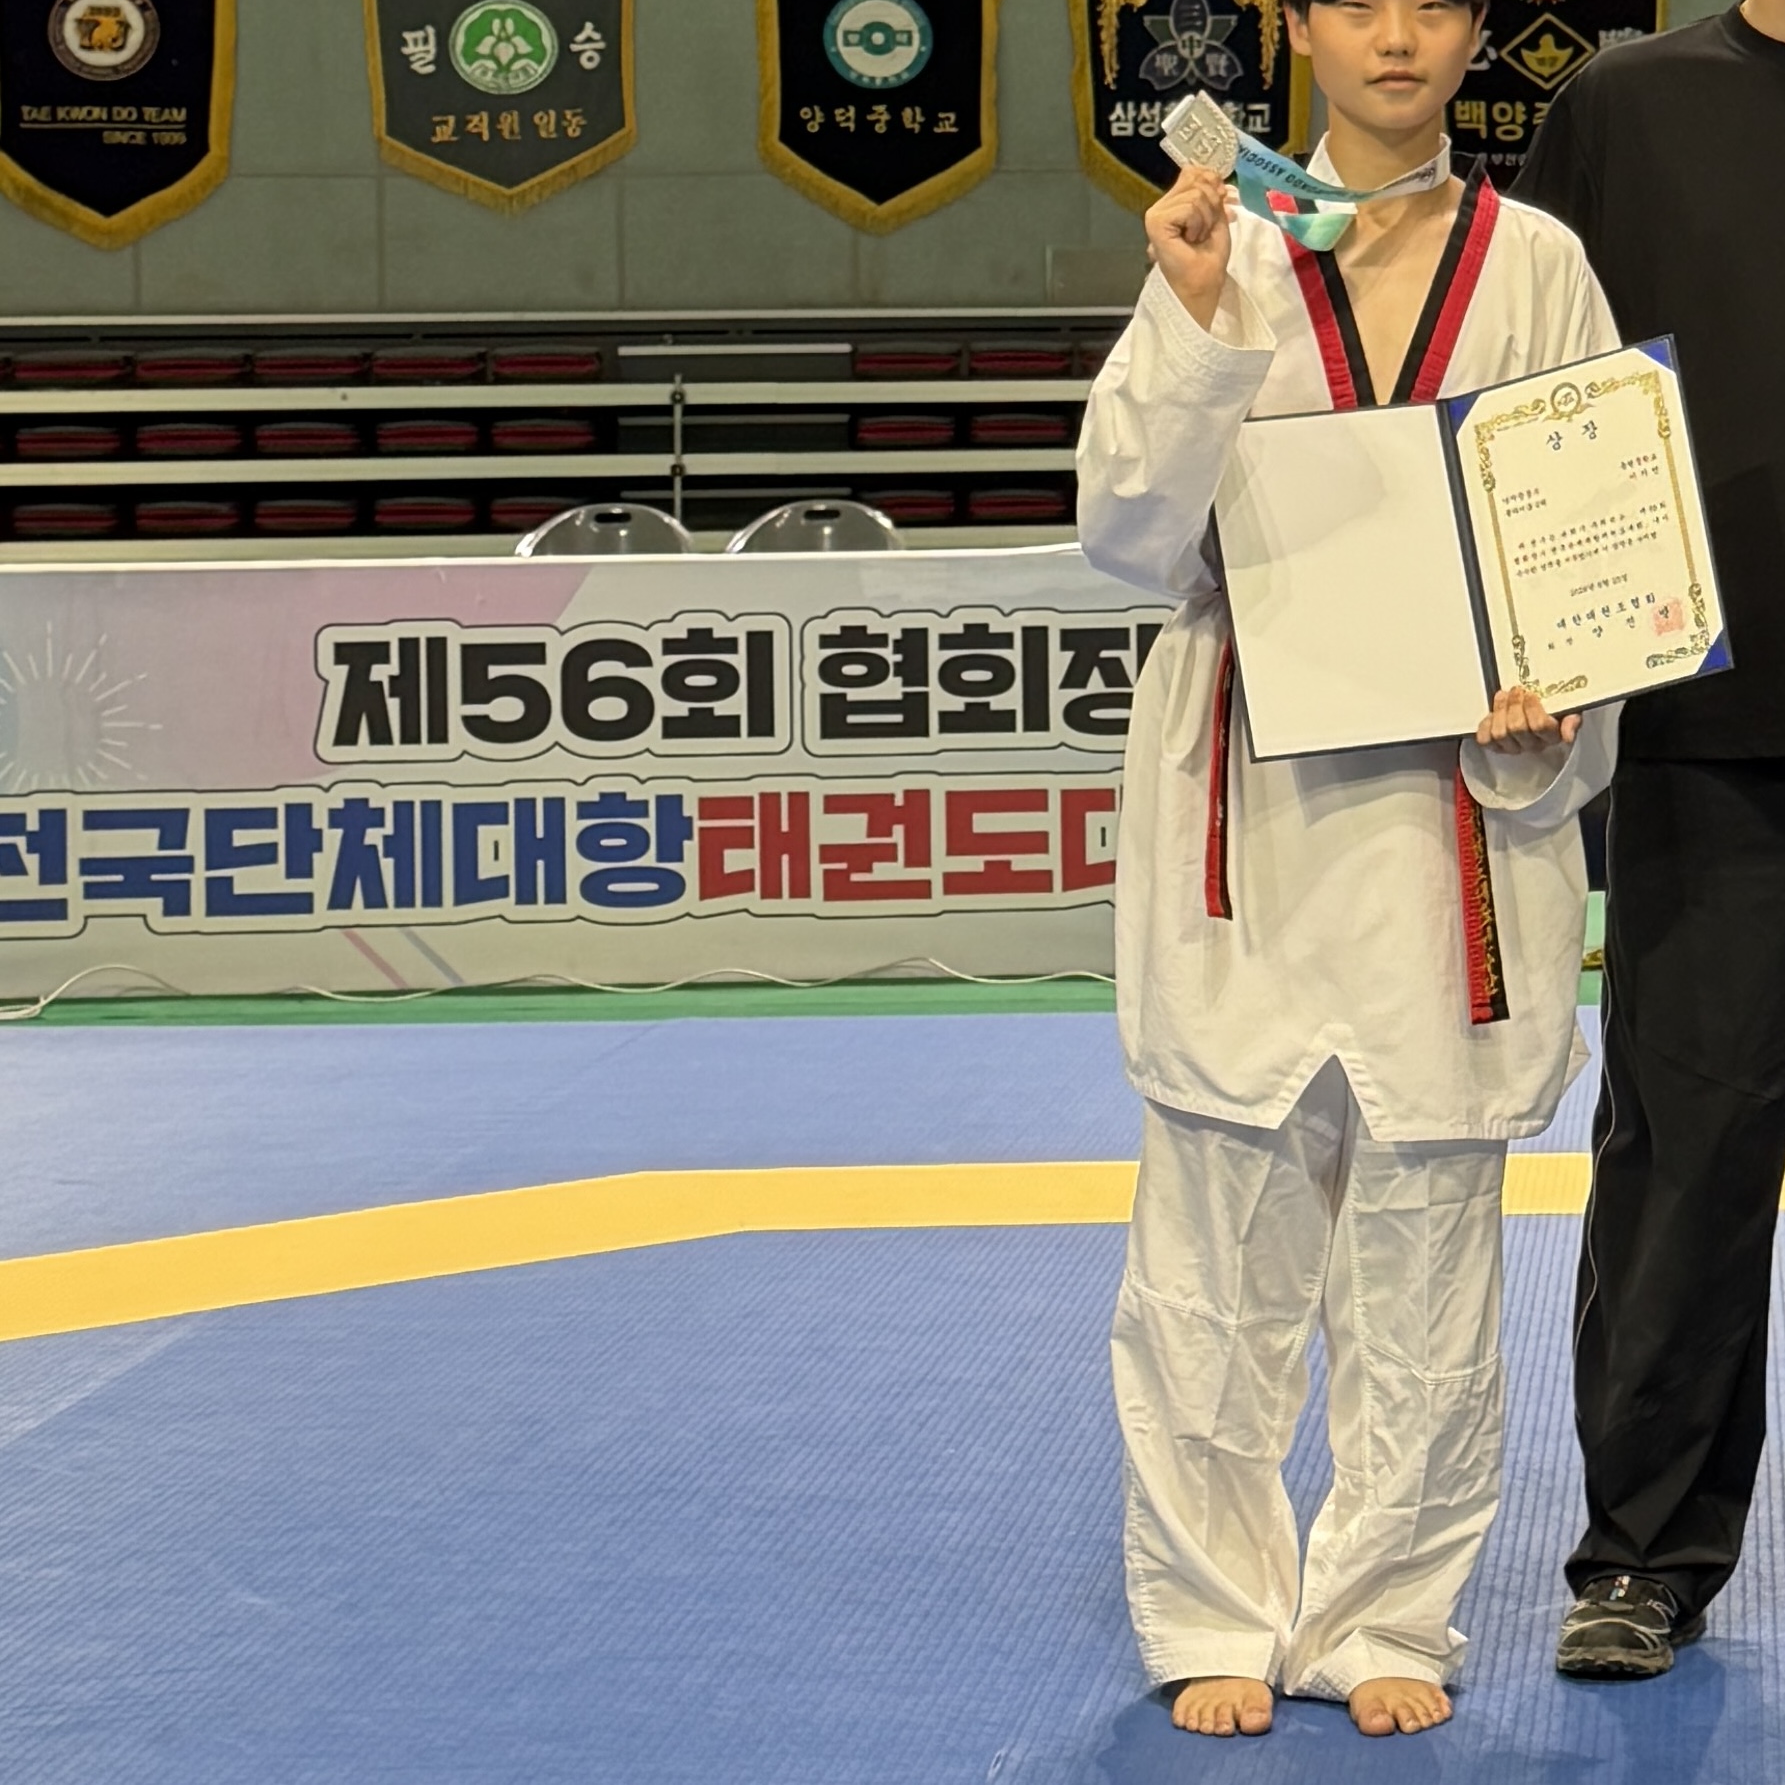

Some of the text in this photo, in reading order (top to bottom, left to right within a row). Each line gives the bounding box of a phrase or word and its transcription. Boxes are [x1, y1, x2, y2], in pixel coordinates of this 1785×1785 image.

[401, 25, 437, 75] 필
[569, 21, 606, 70] 승
[20, 105, 188, 123] TAE KWON DO TEAM
[332, 626, 775, 748] 제56회
